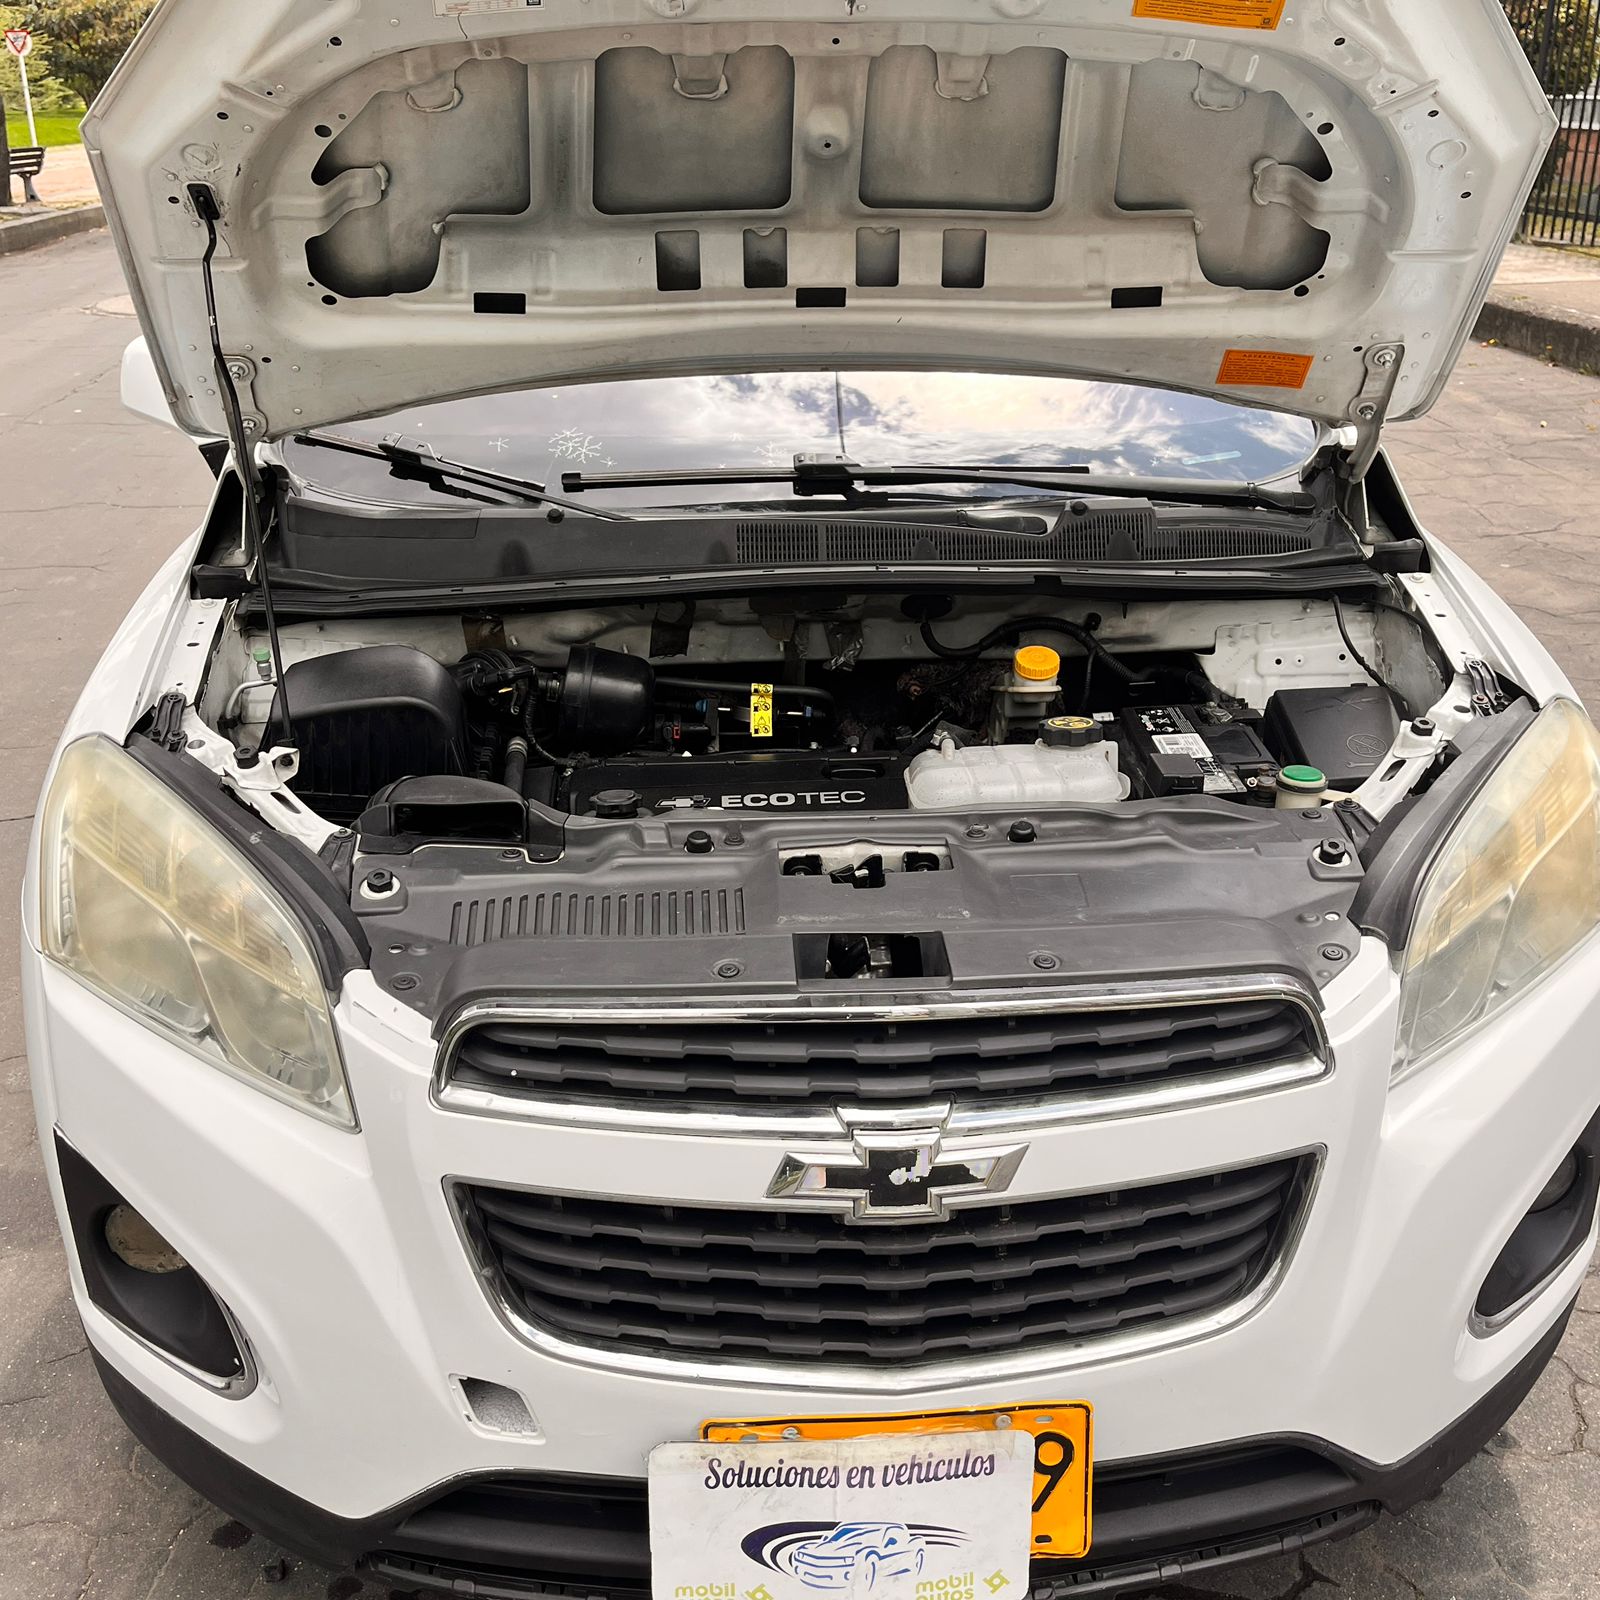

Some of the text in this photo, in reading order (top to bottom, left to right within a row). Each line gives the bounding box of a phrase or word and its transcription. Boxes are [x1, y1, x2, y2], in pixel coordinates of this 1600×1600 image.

[721, 790, 866, 808] ECOTEC
[704, 1448, 996, 1490] Soluciones en vehiculos
[1032, 1431, 1075, 1512] 9
[674, 1582, 736, 1598] mobil
[915, 1571, 974, 1595] mobil
